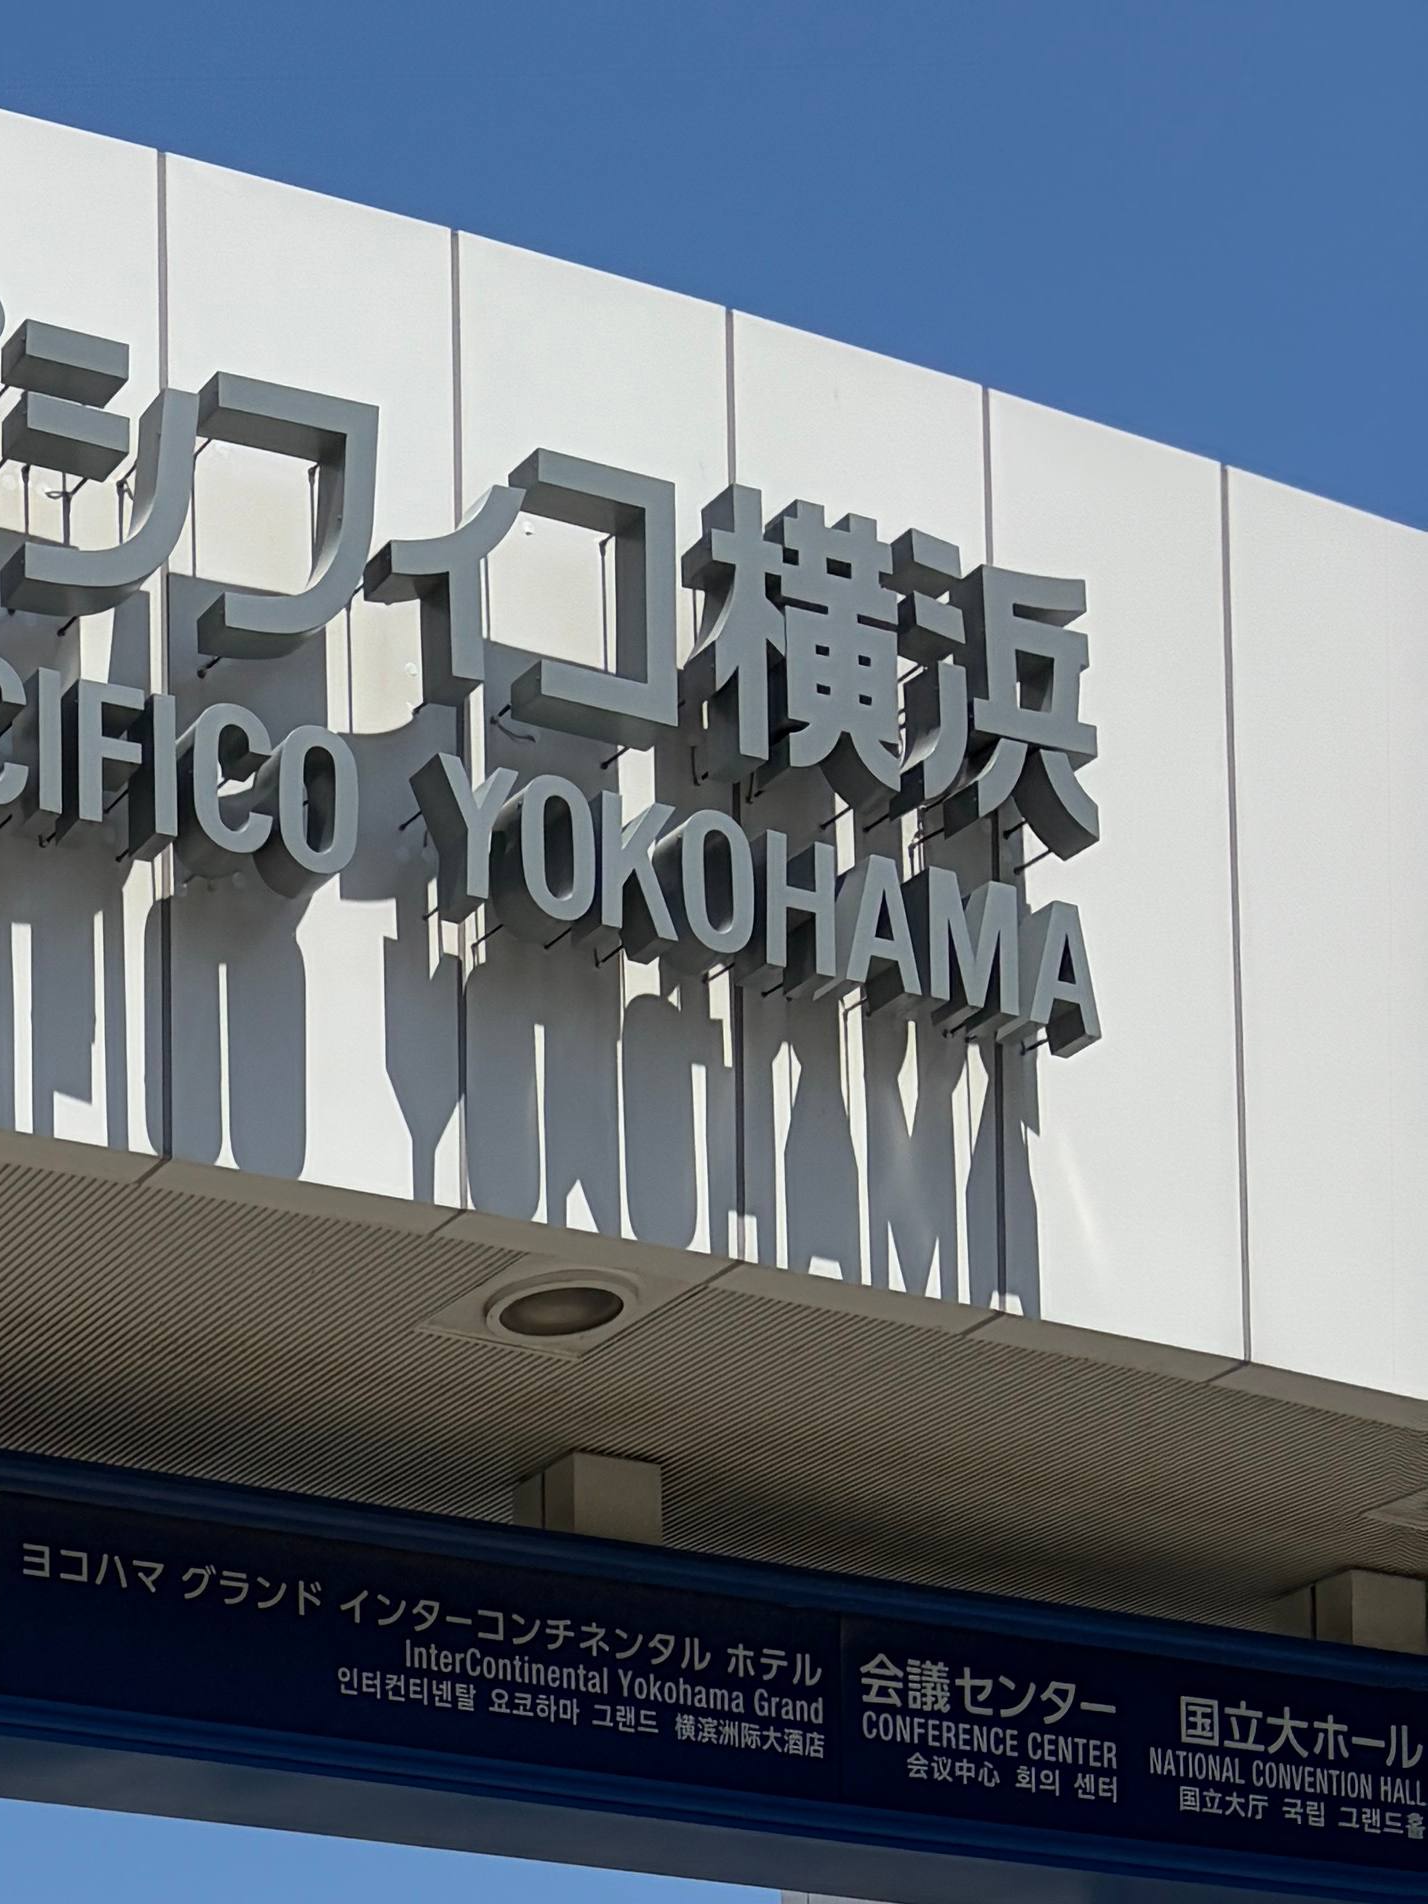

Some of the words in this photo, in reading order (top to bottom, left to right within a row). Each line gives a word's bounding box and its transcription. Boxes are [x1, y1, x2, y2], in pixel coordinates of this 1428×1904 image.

[414, 754, 1100, 1056] YOKOHAMA
[23, 1543, 165, 1593] ヨコハマ
[182, 1564, 321, 1615] グランド
[340, 1589, 711, 1671] インターコンチネンタル
[727, 1643, 822, 1686] ホテル
[338, 1667, 476, 1711] 인터컨티넨탈
[489, 1689, 580, 1725] 요코하마
[592, 1704, 659, 1734] 그랜드
[675, 1713, 825, 1758] 横滨洲际大酒店
[405, 1640, 609, 1694] InterContinental
[618, 1669, 745, 1713] Yokohama
[754, 1688, 824, 1724] Grand
[860, 1653, 1116, 1724] 会議センター
[862, 1711, 1019, 1757] CONFERENCE
[1028, 1732, 1117, 1769] CENTER
[1180, 1695, 1423, 1768] 国立大ホール
[907, 1752, 1000, 1787] 会议中心
[1015, 1766, 1060, 1796] 회의
[1074, 1773, 1117, 1803] 센터
[1149, 1747, 1245, 1784] NATIONAL
[1252, 1760, 1372, 1800] CONVENTION
[1380, 1776, 1427, 1806] HALL
[1179, 1786, 1268, 1819] 国立大厅
[1282, 1798, 1325, 1827] 국립
